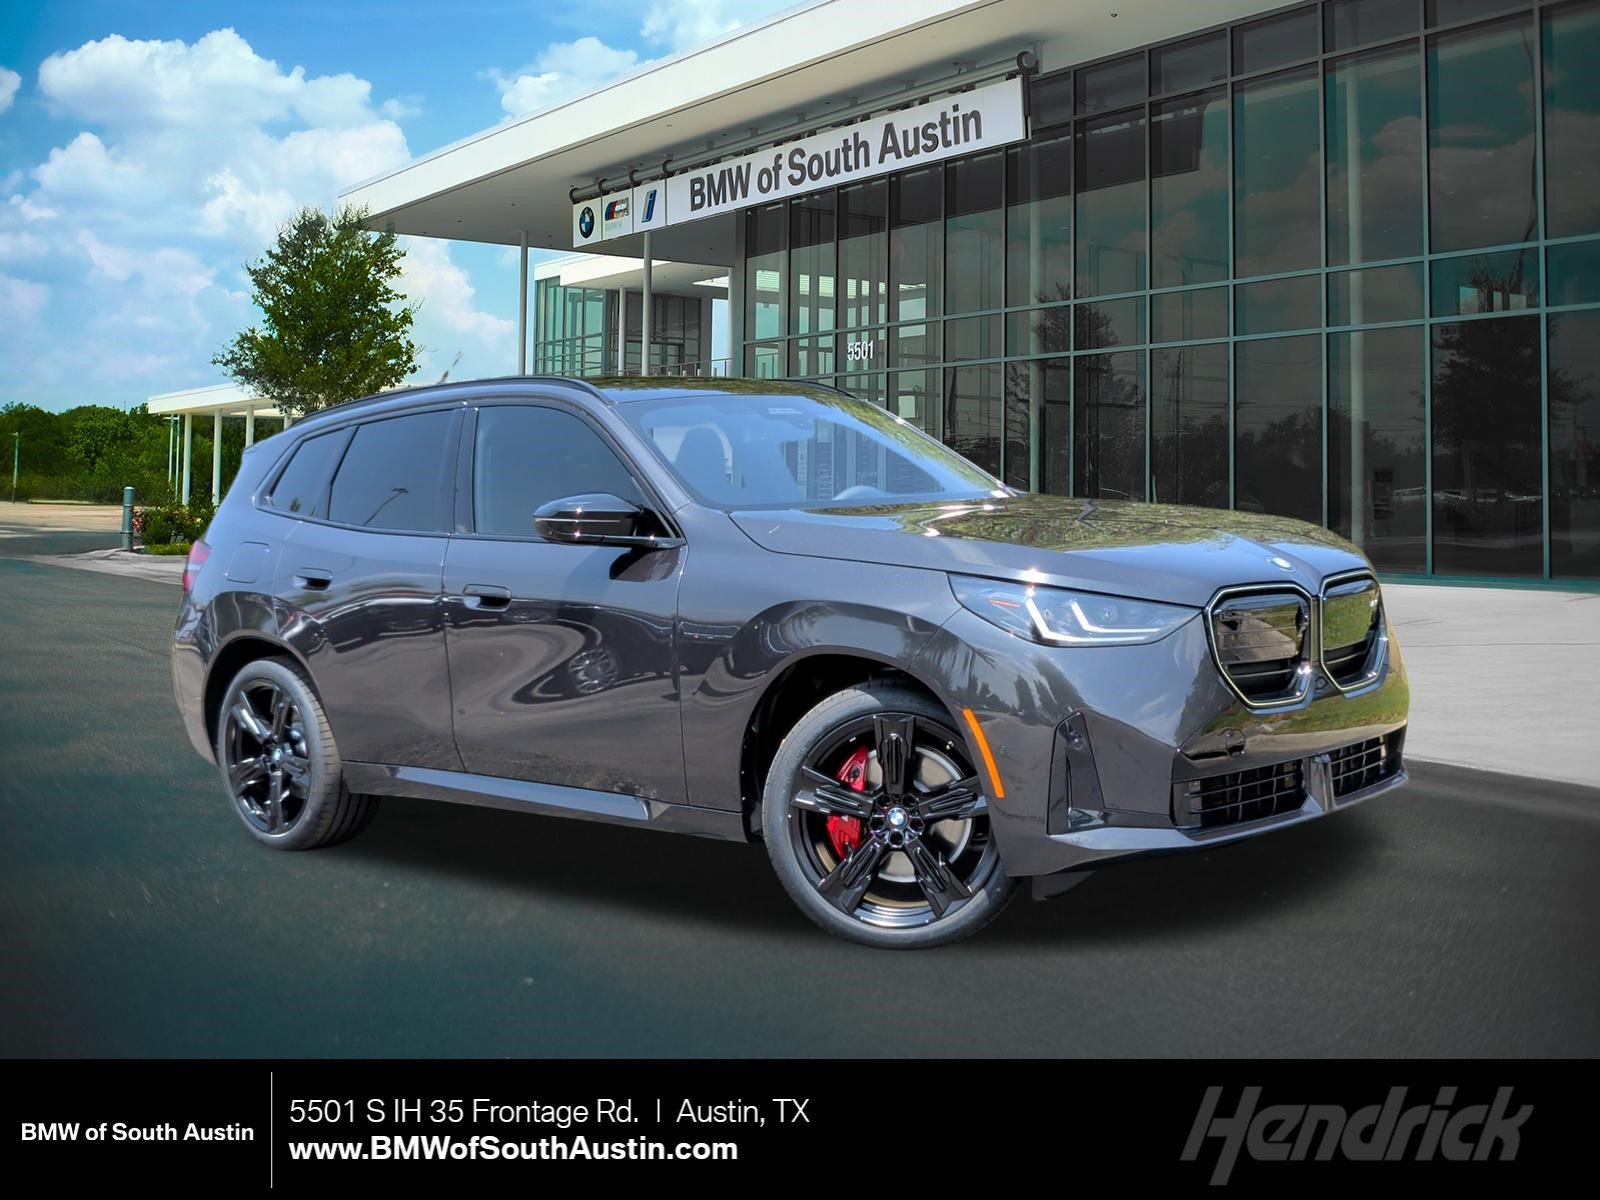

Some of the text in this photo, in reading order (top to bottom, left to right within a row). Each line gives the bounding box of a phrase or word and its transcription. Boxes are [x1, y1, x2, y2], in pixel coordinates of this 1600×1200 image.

[690, 103, 982, 212] BMW of South Austin
[847, 340, 873, 361] 5501
